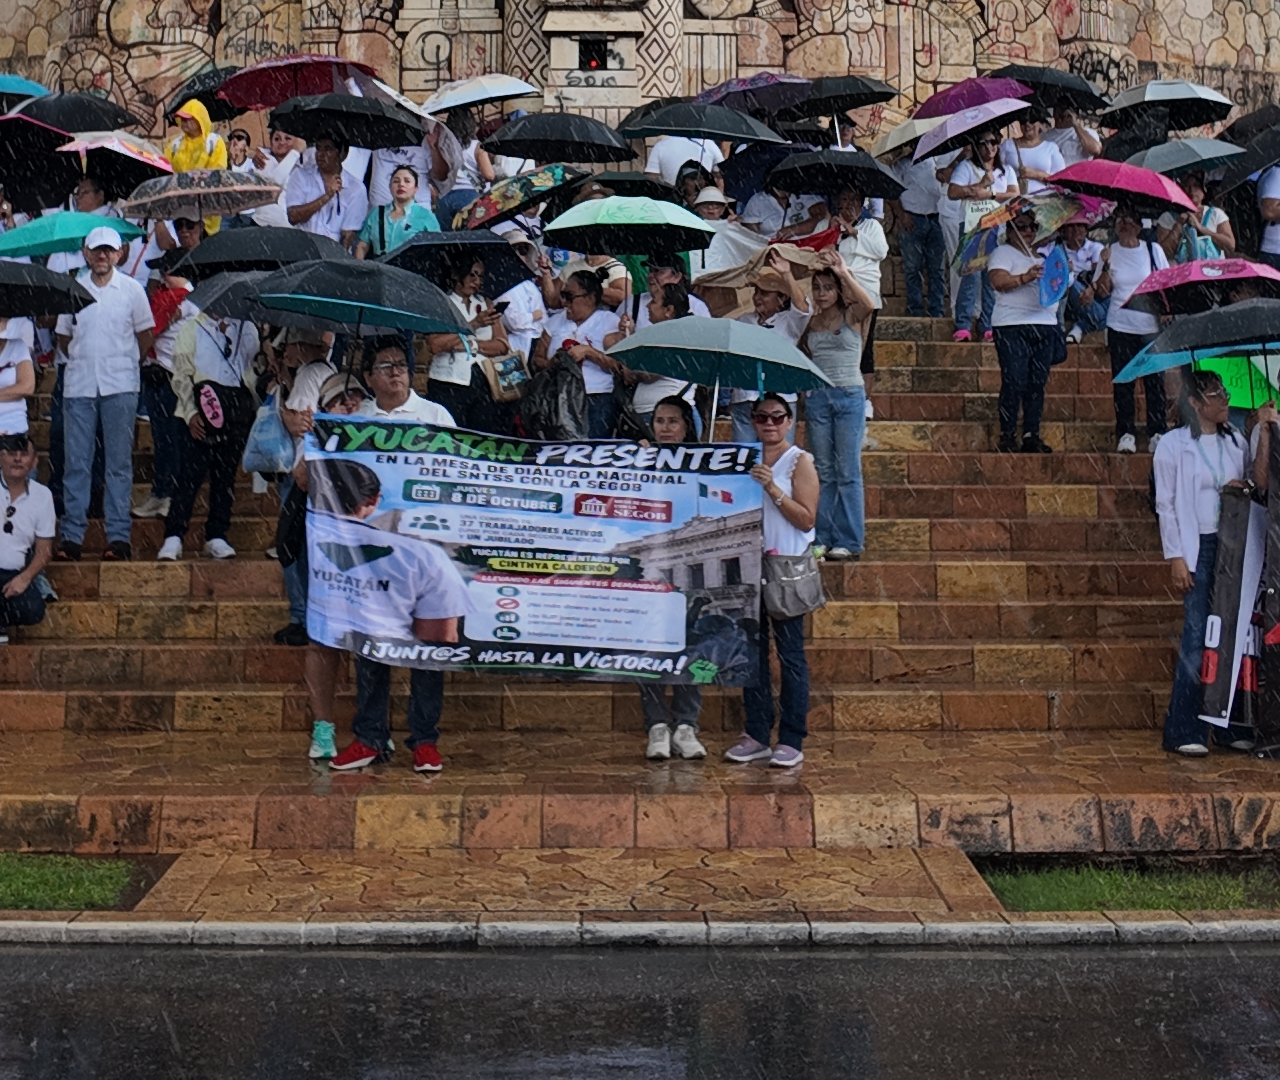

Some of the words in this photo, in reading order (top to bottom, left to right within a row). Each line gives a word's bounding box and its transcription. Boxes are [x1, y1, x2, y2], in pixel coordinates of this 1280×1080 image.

[535, 443, 750, 472] PRESENTE!
[375, 454, 398, 465] EN
[403, 456, 426, 467] LA
[431, 457, 481, 473] MESA
[487, 462, 509, 474] DE
[514, 462, 590, 480] DIÁLOGO
[596, 470, 687, 485] NACIONAL
[419, 466, 450, 479] DEL
[456, 469, 514, 483] SNTSS
[520, 474, 554, 488] CON
[559, 478, 581, 490] LA
[586, 480, 643, 492] SEGOB
[452, 485, 498, 495] JUEVES
[451, 492, 463, 504] 8
[466, 493, 487, 505] DE
[490, 495, 558, 512] OCTUBRE
[613, 509, 667, 521] SEGOB
[459, 520, 474, 528] 37
[478, 521, 560, 535] TRABAJADORES
[561, 528, 604, 538] ACTIVOS
[483, 535, 536, 545] JUBILADO
[471, 547, 519, 558] YUCATÁN
[551, 562, 612, 573] CALDERÓN
[477, 649, 535, 664] HASTA
[541, 651, 565, 665] LA
